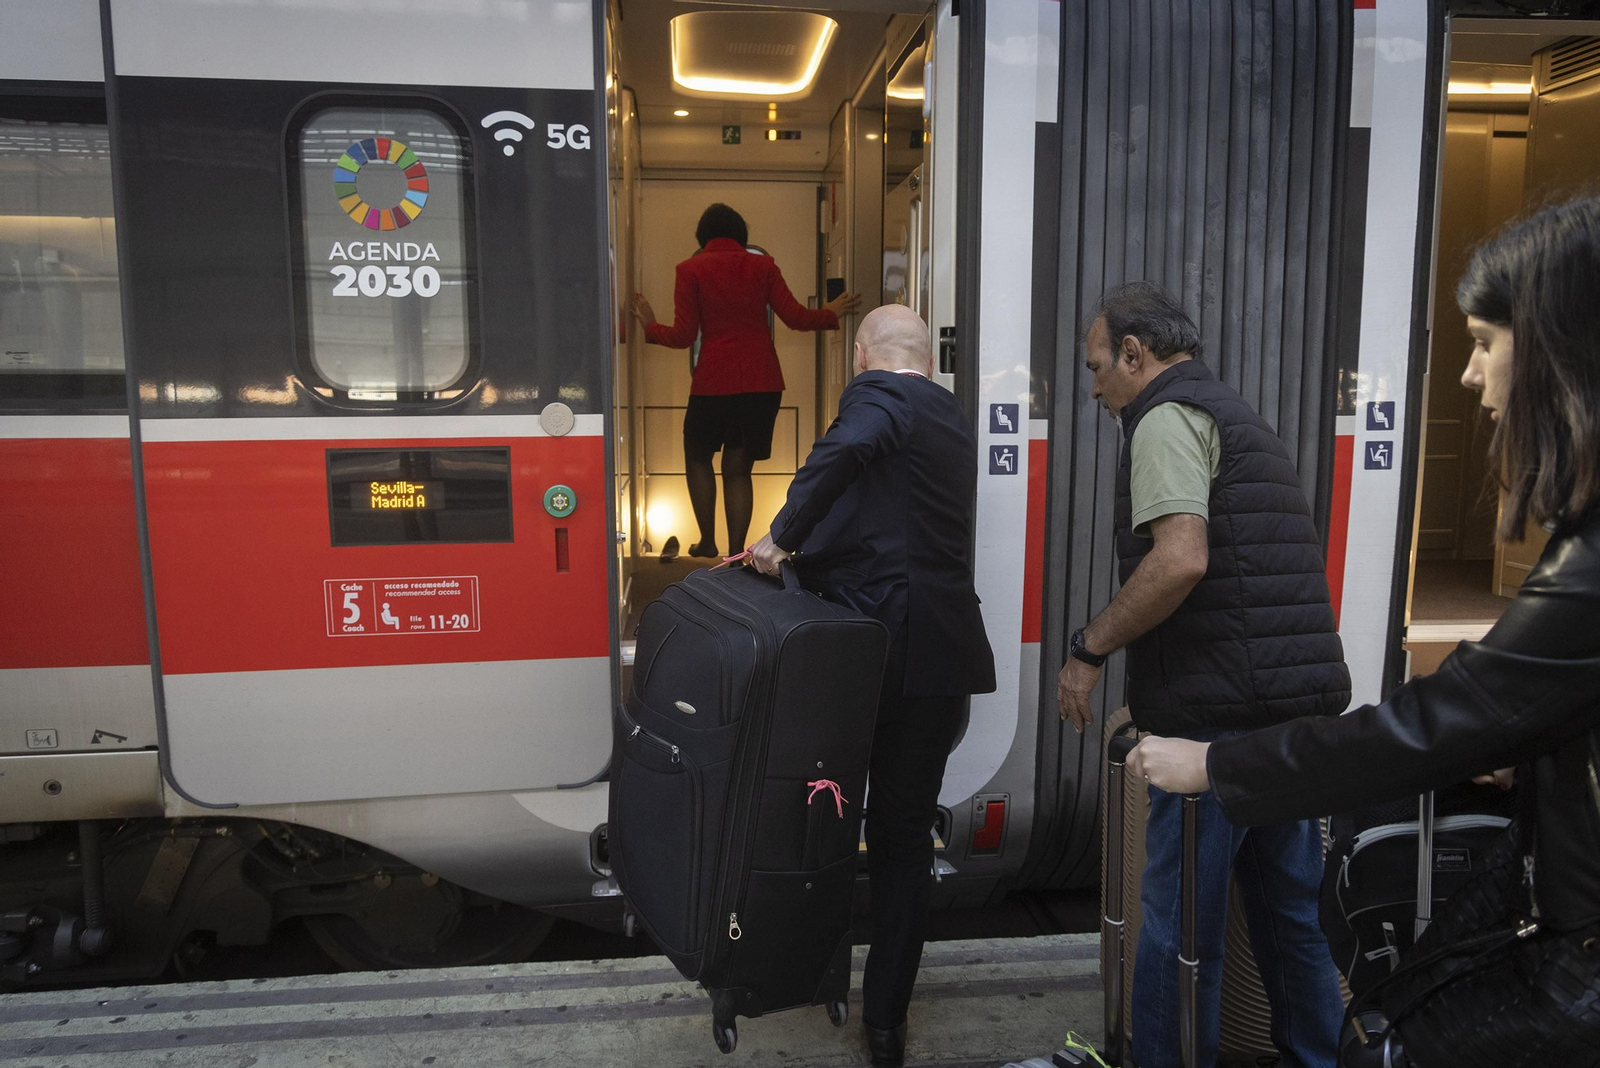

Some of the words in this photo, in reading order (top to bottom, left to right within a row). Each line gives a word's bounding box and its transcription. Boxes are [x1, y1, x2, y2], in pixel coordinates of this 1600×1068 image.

[546, 123, 592, 150] 5G
[328, 241, 440, 262] AGENDA
[331, 265, 441, 297] 2030
[371, 481, 424, 494] Sevilla-
[371, 495, 414, 508] Madrid
[416, 494, 425, 507] A
[340, 583, 363, 591] Coche
[410, 580, 460, 588] recomendado
[385, 588, 436, 597] recommended
[437, 588, 461, 596] access
[343, 592, 361, 624] 5
[343, 624, 364, 632] Coach
[429, 614, 469, 629] 11-20
